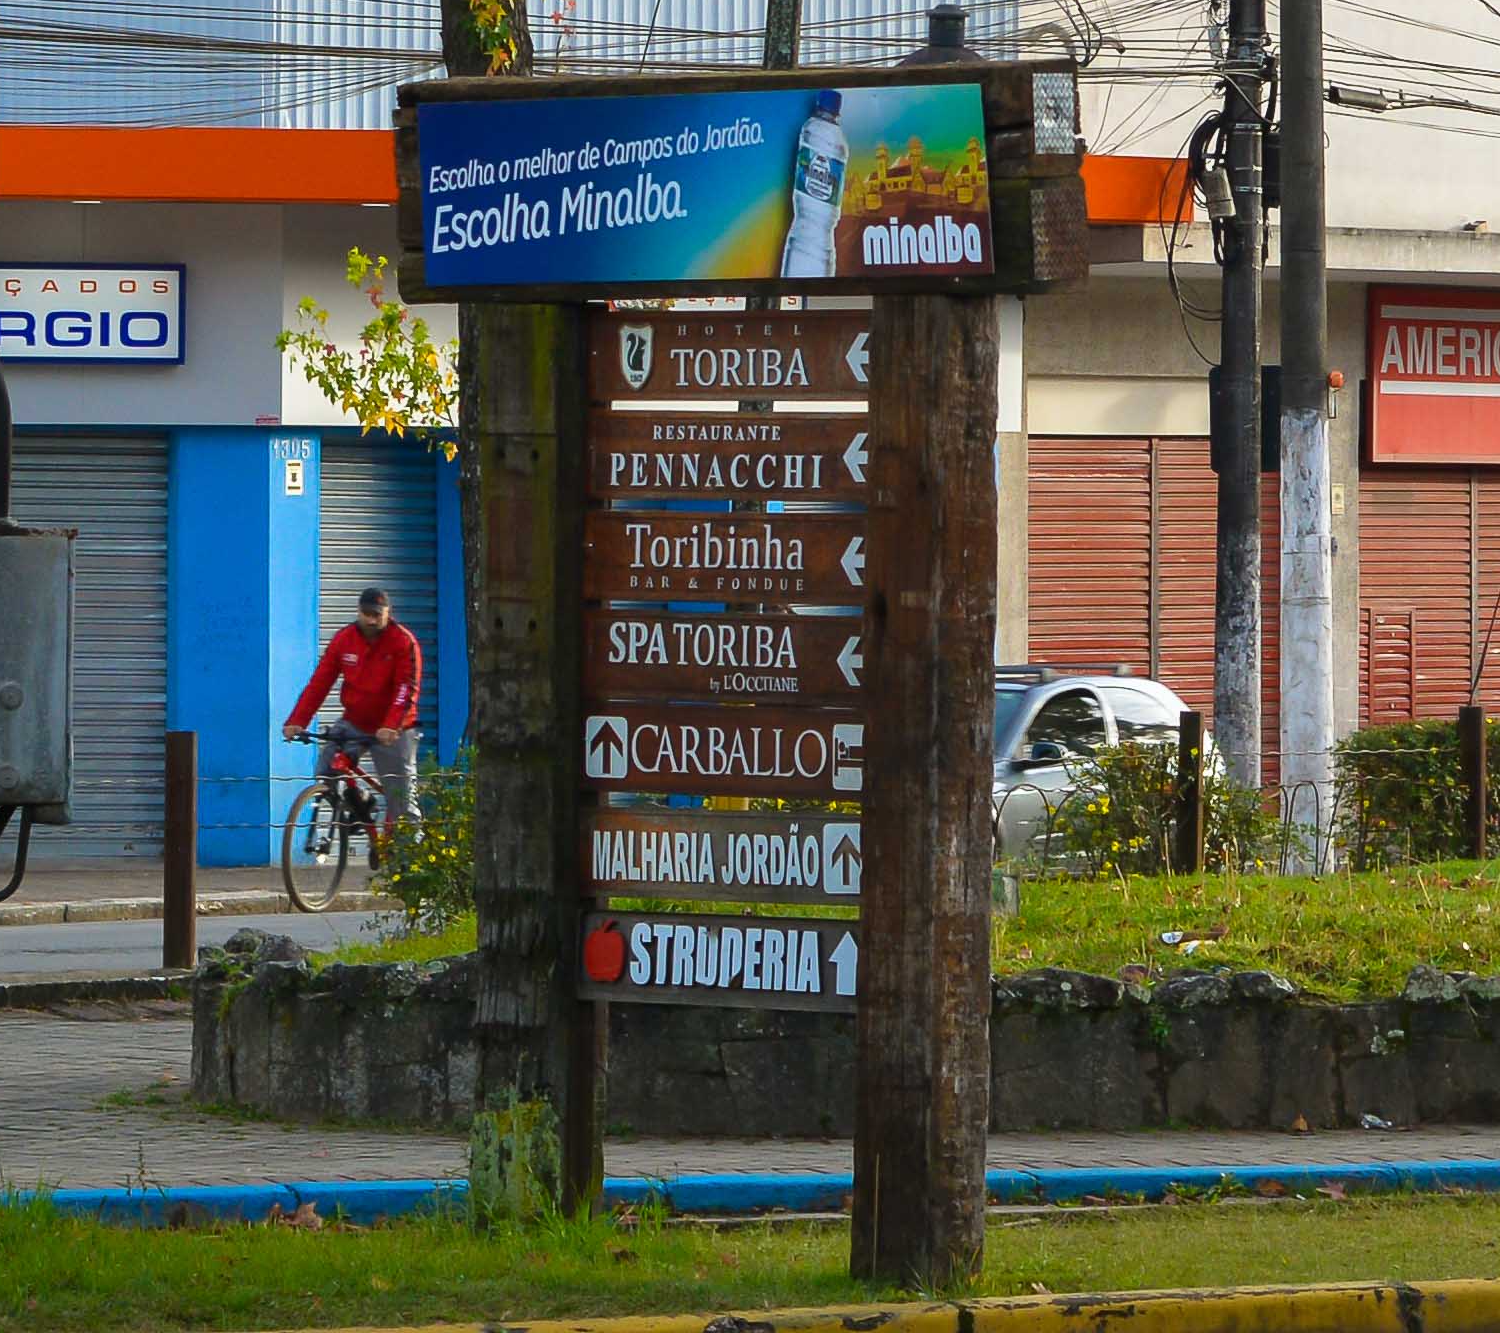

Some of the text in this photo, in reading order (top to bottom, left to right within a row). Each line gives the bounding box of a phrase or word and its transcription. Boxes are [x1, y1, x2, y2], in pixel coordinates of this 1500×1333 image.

[429, 117, 764, 194] Escolha o melhor de Campos do Jordão.
[432, 173, 687, 254] Escolha Minalba.
[863, 216, 982, 265] minalba
[678, 324, 801, 337] HOTEL
[670, 348, 809, 387] TORIBA
[273, 437, 312, 460] 1305
[653, 424, 781, 441] RESTAURANTE
[610, 452, 823, 488] PENNACCHI
[626, 522, 804, 571] Toribinha
[630, 575, 804, 591] BAR & FONDUE
[609, 621, 797, 669] SPA TORIBA
[631, 724, 827, 779] CARBALLO
[592, 823, 820, 887] MALHARIA JORDÃO
